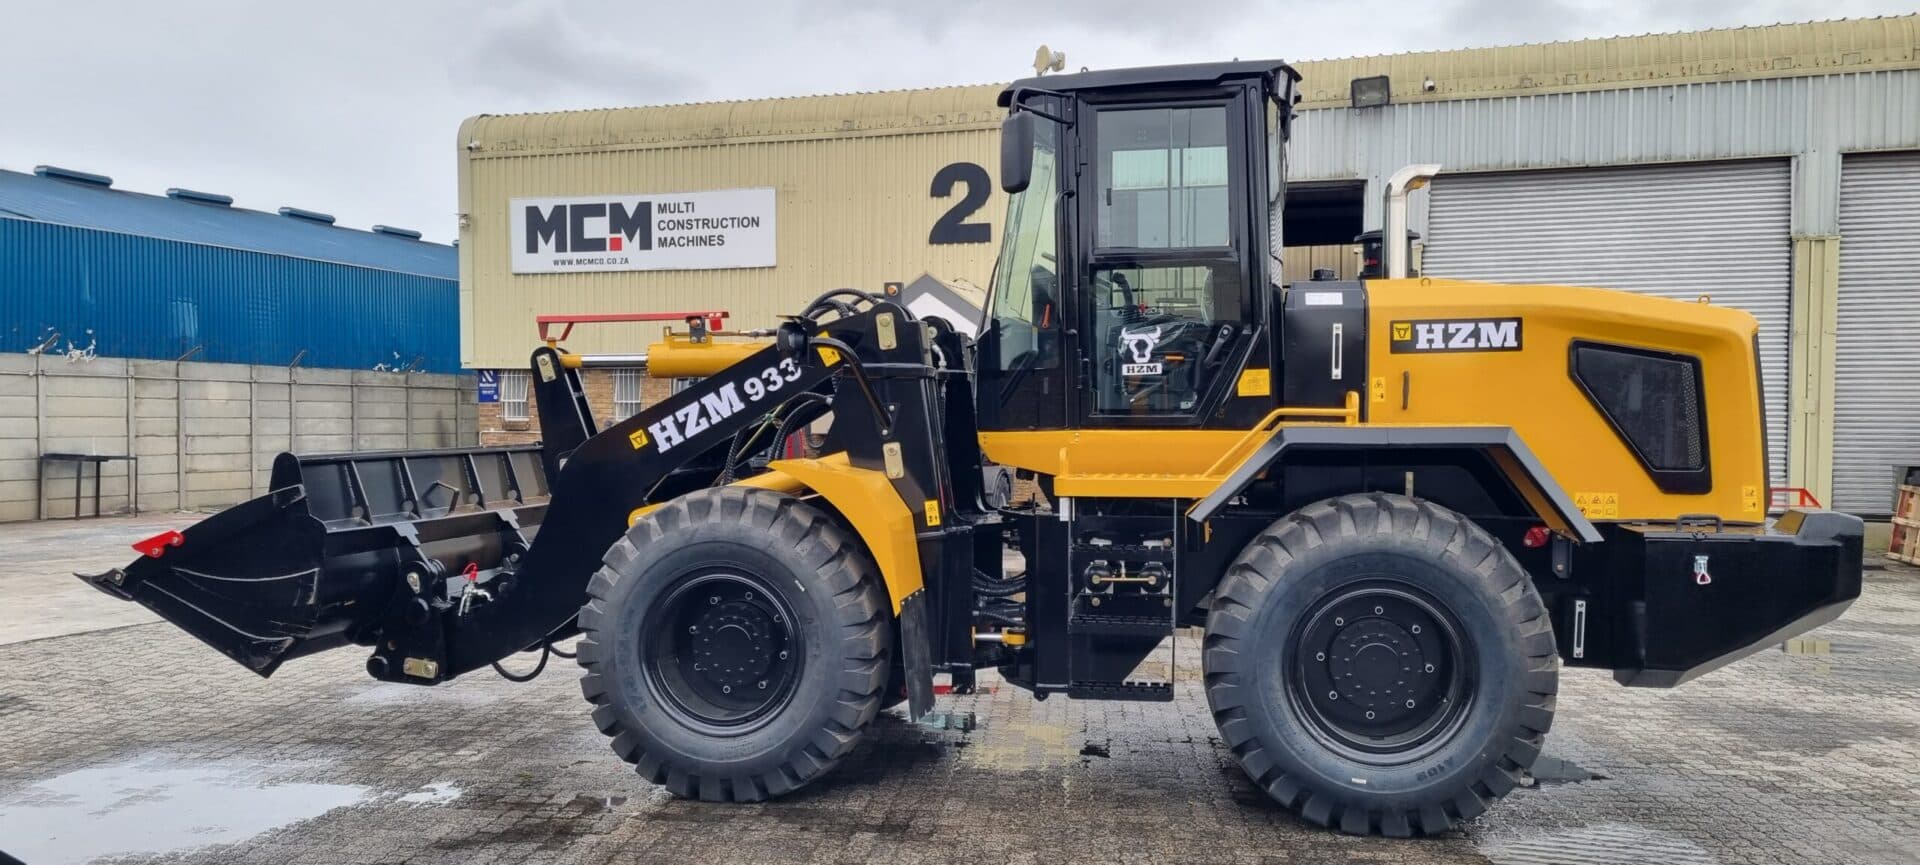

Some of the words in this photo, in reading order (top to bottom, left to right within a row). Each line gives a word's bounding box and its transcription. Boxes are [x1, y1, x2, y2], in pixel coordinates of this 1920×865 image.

[657, 202, 695, 215] MULTI
[928, 162, 992, 245] 2
[525, 201, 653, 254] MCM
[657, 216, 760, 231] CONSTRUCTION
[657, 234, 725, 248] MACHINES
[552, 257, 630, 266] WWW.MCMCO.CO.ZA
[1415, 321, 1518, 350] HZM
[1126, 365, 1158, 374] HZM
[648, 381, 746, 454] HZM
[743, 357, 802, 402] 933
